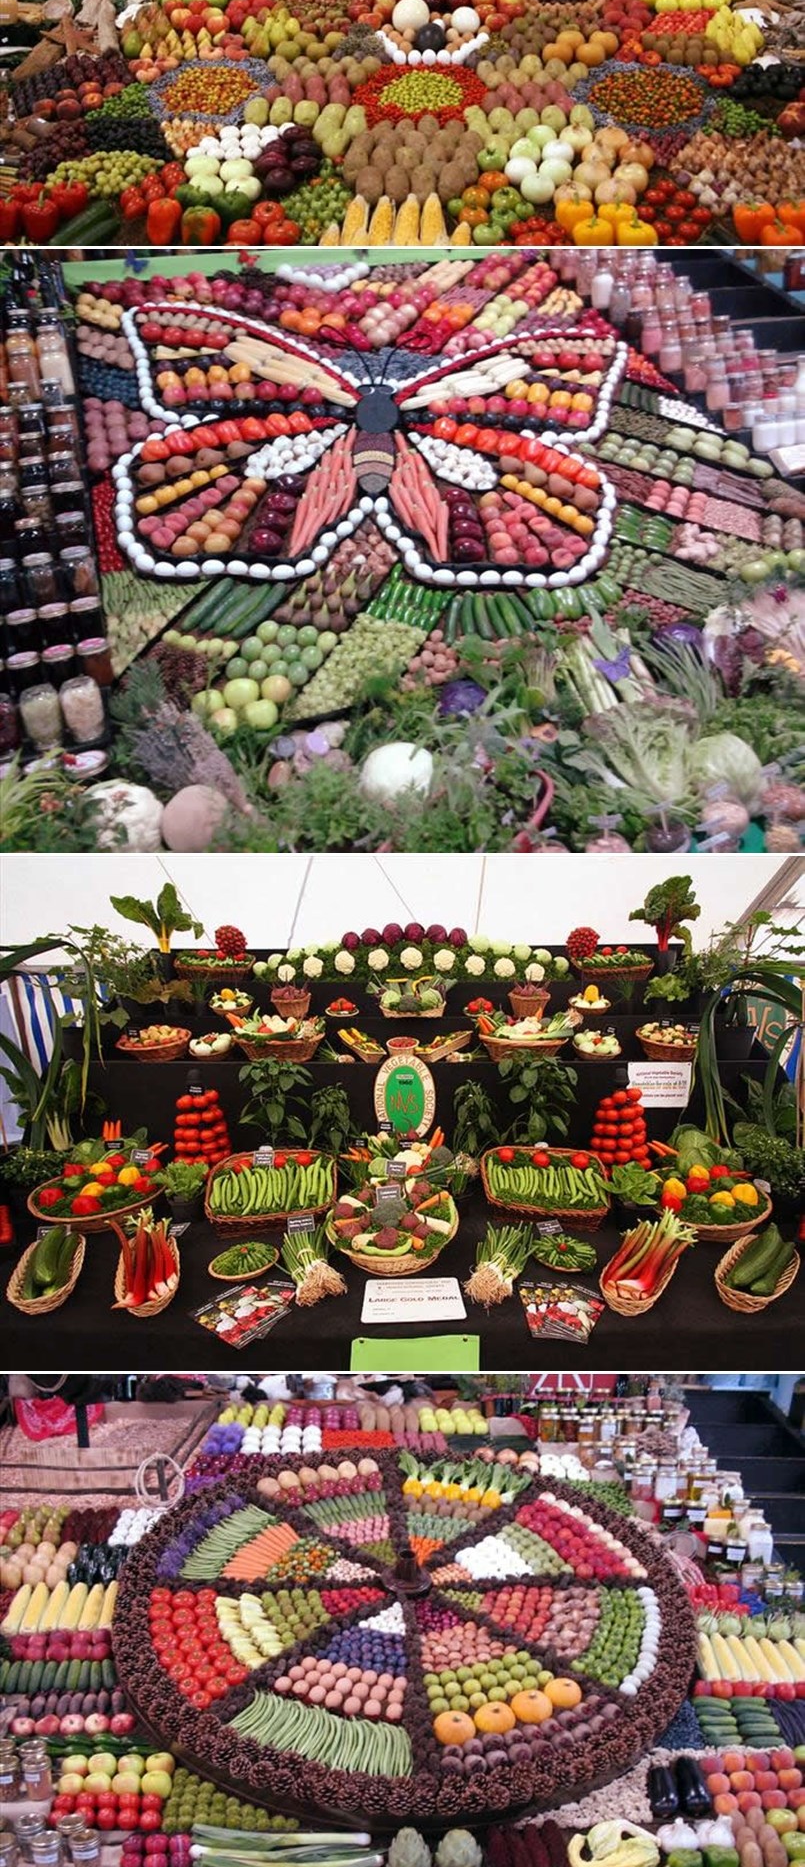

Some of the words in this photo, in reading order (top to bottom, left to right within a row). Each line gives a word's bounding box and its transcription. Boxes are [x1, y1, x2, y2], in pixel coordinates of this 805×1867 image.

[382, 1056, 430, 1081] VEGETABLE
[376, 1081, 386, 1122] ATIONAL
[422, 1089, 434, 1129] SOCIETY
